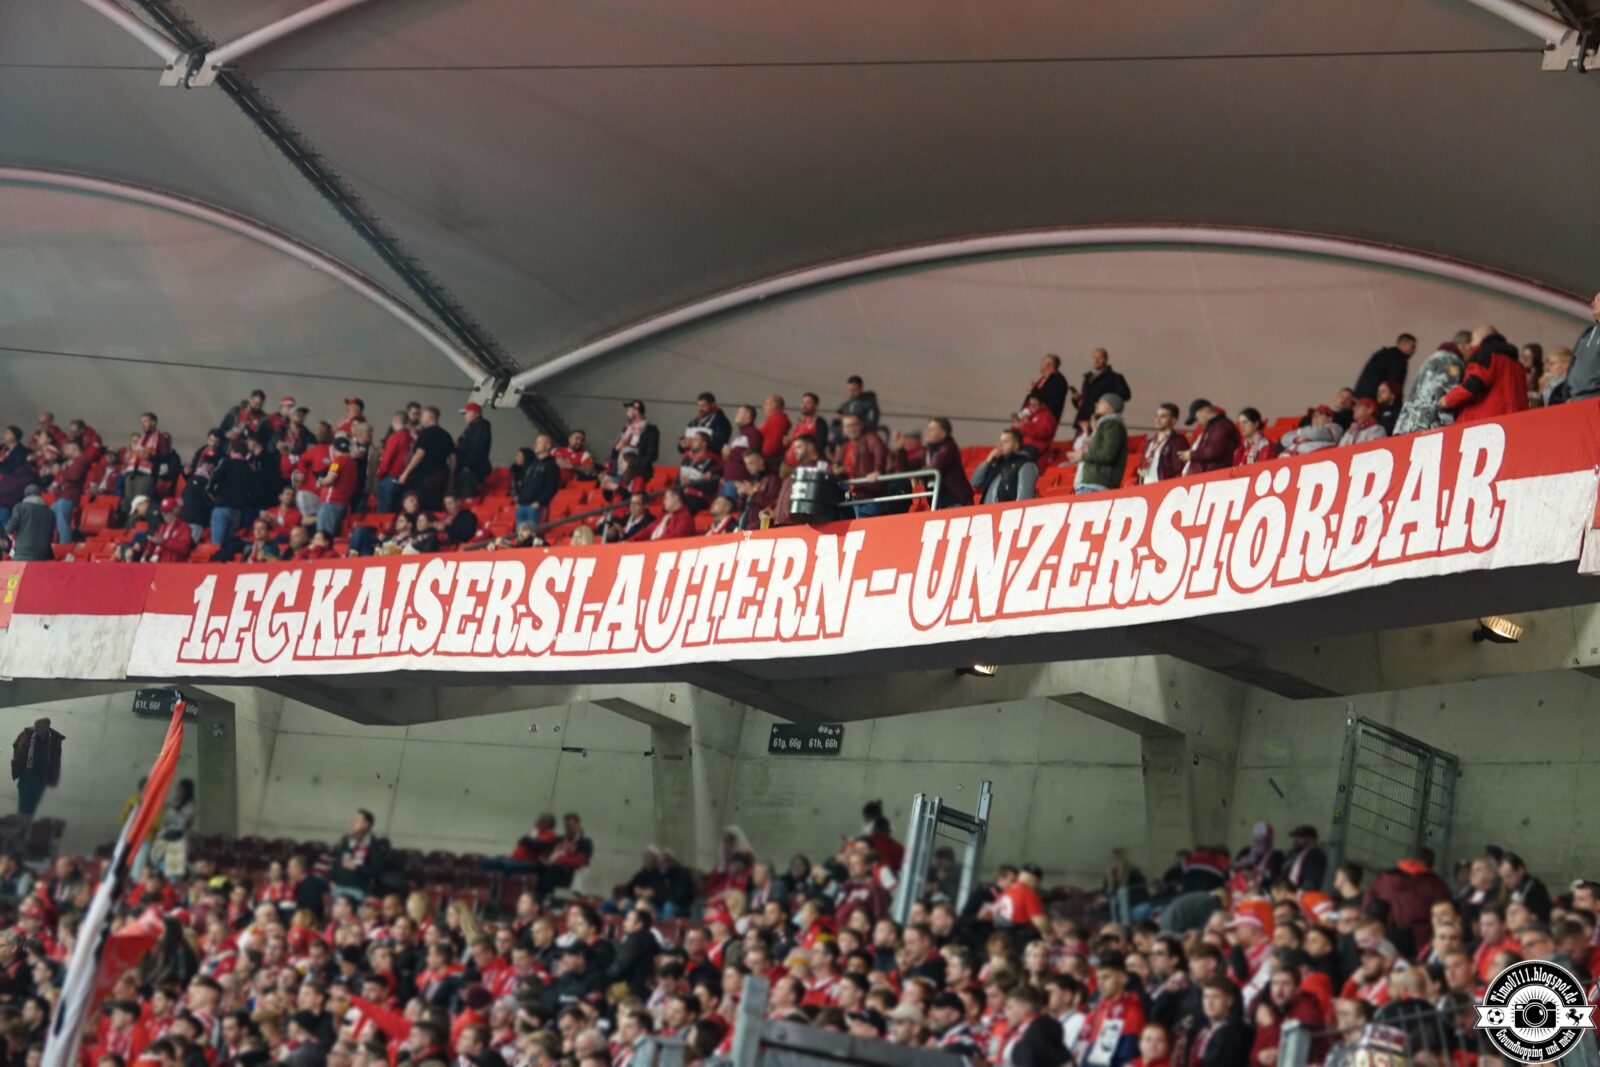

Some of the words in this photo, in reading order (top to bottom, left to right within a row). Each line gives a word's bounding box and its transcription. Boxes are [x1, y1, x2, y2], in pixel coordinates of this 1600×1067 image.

[909, 422, 1507, 630] UNZERSTÖRBAR
[772, 738, 787, 750] 61g,
[788, 738, 802, 750] 66g
[808, 738, 823, 749] 61h,
[824, 738, 838, 749] 66h
